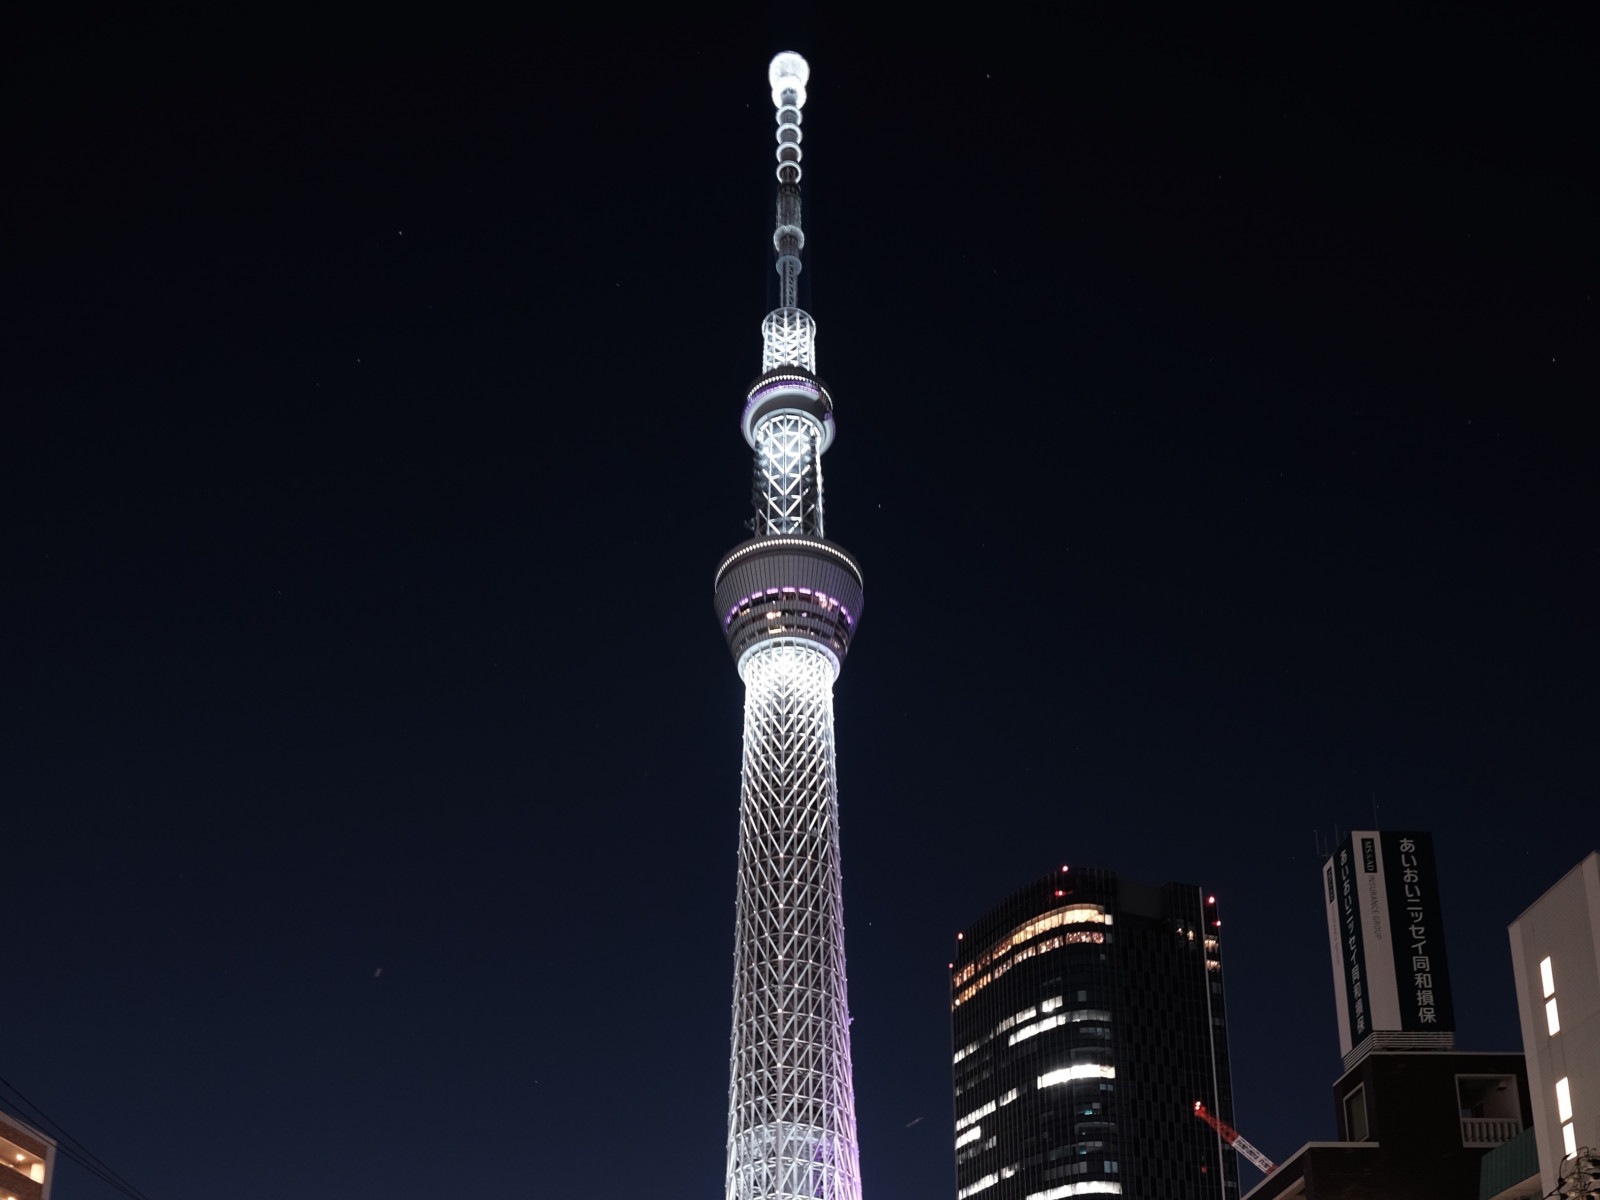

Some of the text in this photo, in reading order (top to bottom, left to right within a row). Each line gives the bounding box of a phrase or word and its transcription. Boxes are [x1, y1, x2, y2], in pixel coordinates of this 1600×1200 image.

[1363, 840, 1382, 940] MS&AD INSURANCE GROUP
[1400, 837, 1436, 1023] あいおいニッセイ同和損保
